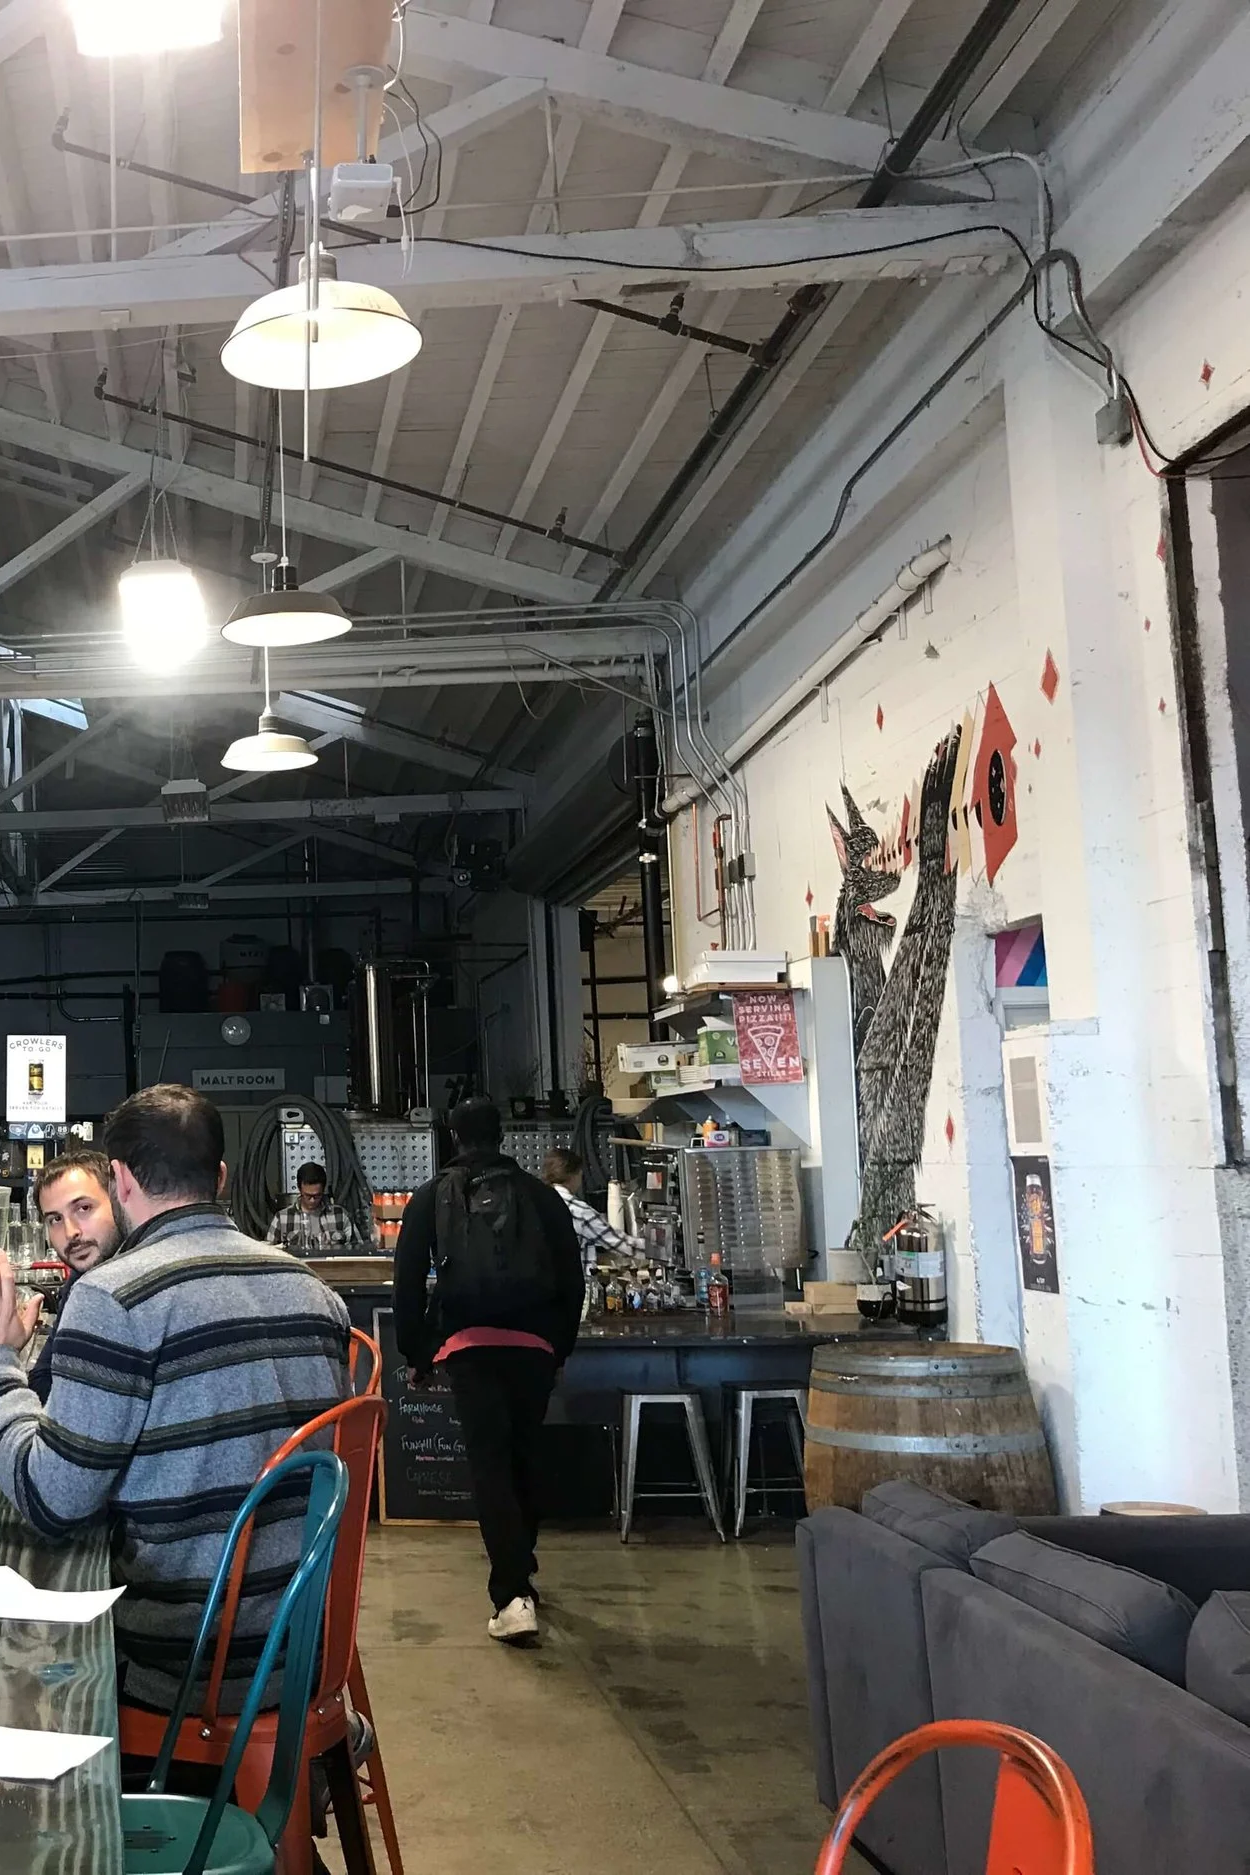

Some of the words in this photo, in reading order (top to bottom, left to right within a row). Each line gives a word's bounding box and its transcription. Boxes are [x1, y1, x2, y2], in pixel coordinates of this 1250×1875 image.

[749, 995, 777, 1003] NOW
[738, 1004, 790, 1014] SERVING
[9, 1038, 63, 1050] CROWLERS
[200, 1075, 235, 1086] MALT
[236, 1074, 275, 1085] ROOM
